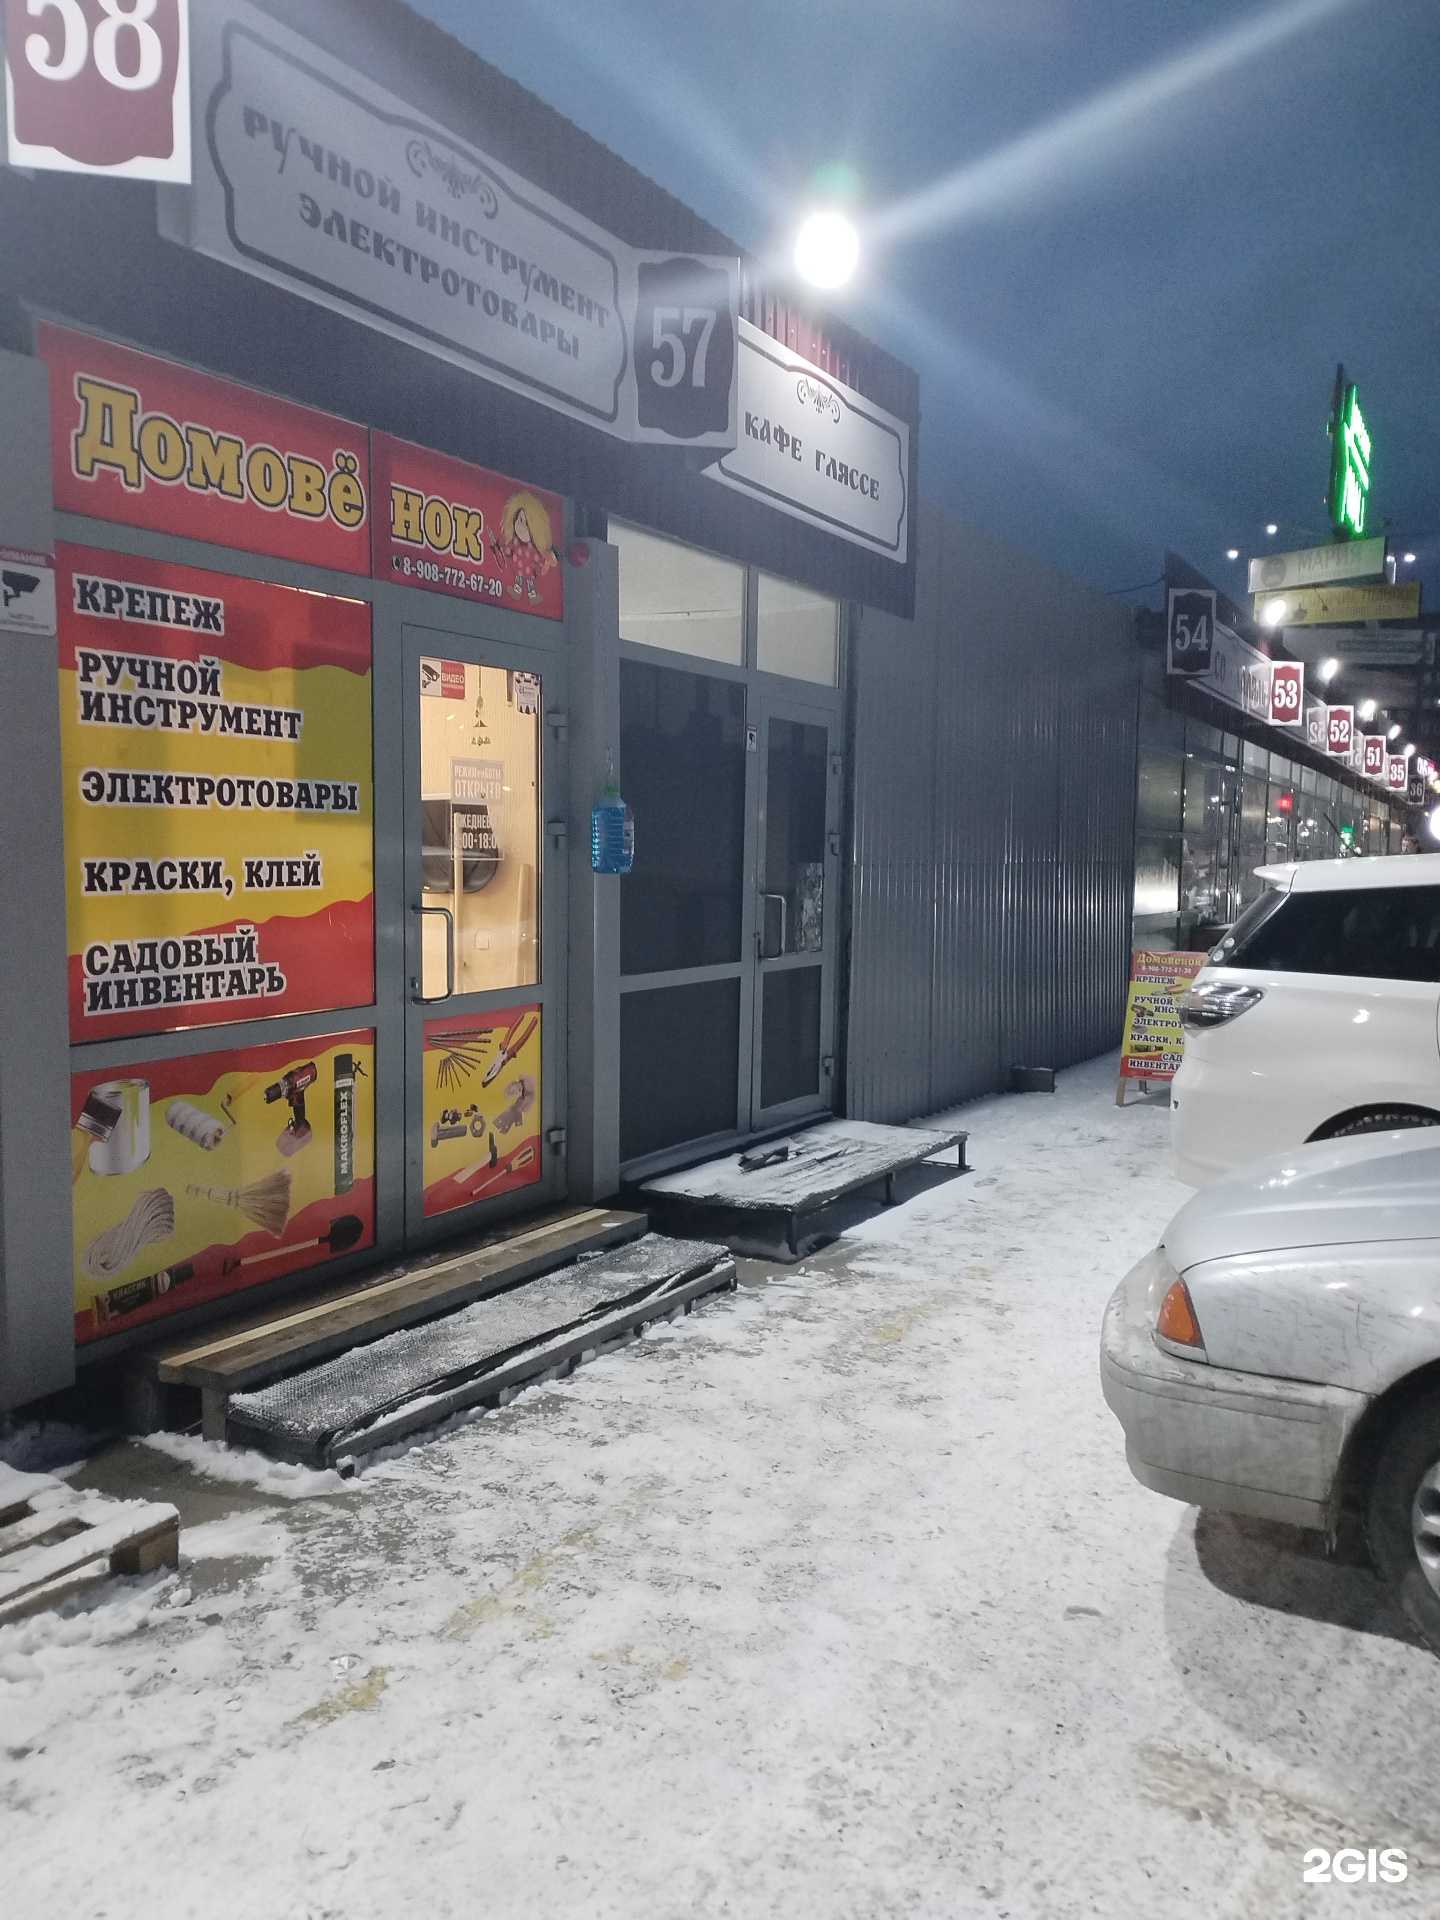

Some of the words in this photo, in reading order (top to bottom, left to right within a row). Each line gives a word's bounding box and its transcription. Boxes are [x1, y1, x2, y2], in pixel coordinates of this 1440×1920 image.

[25, 0, 163, 90] 58
[243, 106, 399, 214] РУЧНОЙ
[416, 200, 610, 328] ИНСТРУМЕНТ
[300, 193, 579, 359] ЭЛЕКТРОТОВАРЫ
[650, 306, 717, 388] 57
[73, 375, 366, 529] Домовё
[744, 410, 802, 462] КАФЕ
[815, 449, 880, 501] ГЛЯССЕ
[404, 556, 503, 597] 8-908-772-67-20
[76, 577, 223, 632] КРЕПЕЖ
[1174, 613, 1209, 651] 54
[78, 651, 221, 697] РУЧНОЙ
[1273, 679, 1299, 710] 53
[80, 689, 302, 740] ИНСТРУМЕНТ
[1329, 719, 1350, 743] 52
[1366, 746, 1381, 767] 51
[1390, 763, 1405, 781] 35
[82, 771, 358, 811] ЭЛЕКТРОТОВАРЫ
[455, 779, 501, 800] ОТКРЫТО
[84, 860, 233, 895] КРАСКИ,
[245, 853, 322, 888] КЛЕЙ
[85, 929, 257, 976] САДОВЫЙ
[86, 969, 285, 1013] ИНВЕНТАРЬ
[1134, 995, 1174, 1006] РУЧНОЙ
[1135, 975, 1176, 985] КРЕПЕЖ
[341, 1090, 350, 1175] MAKROFLEX
